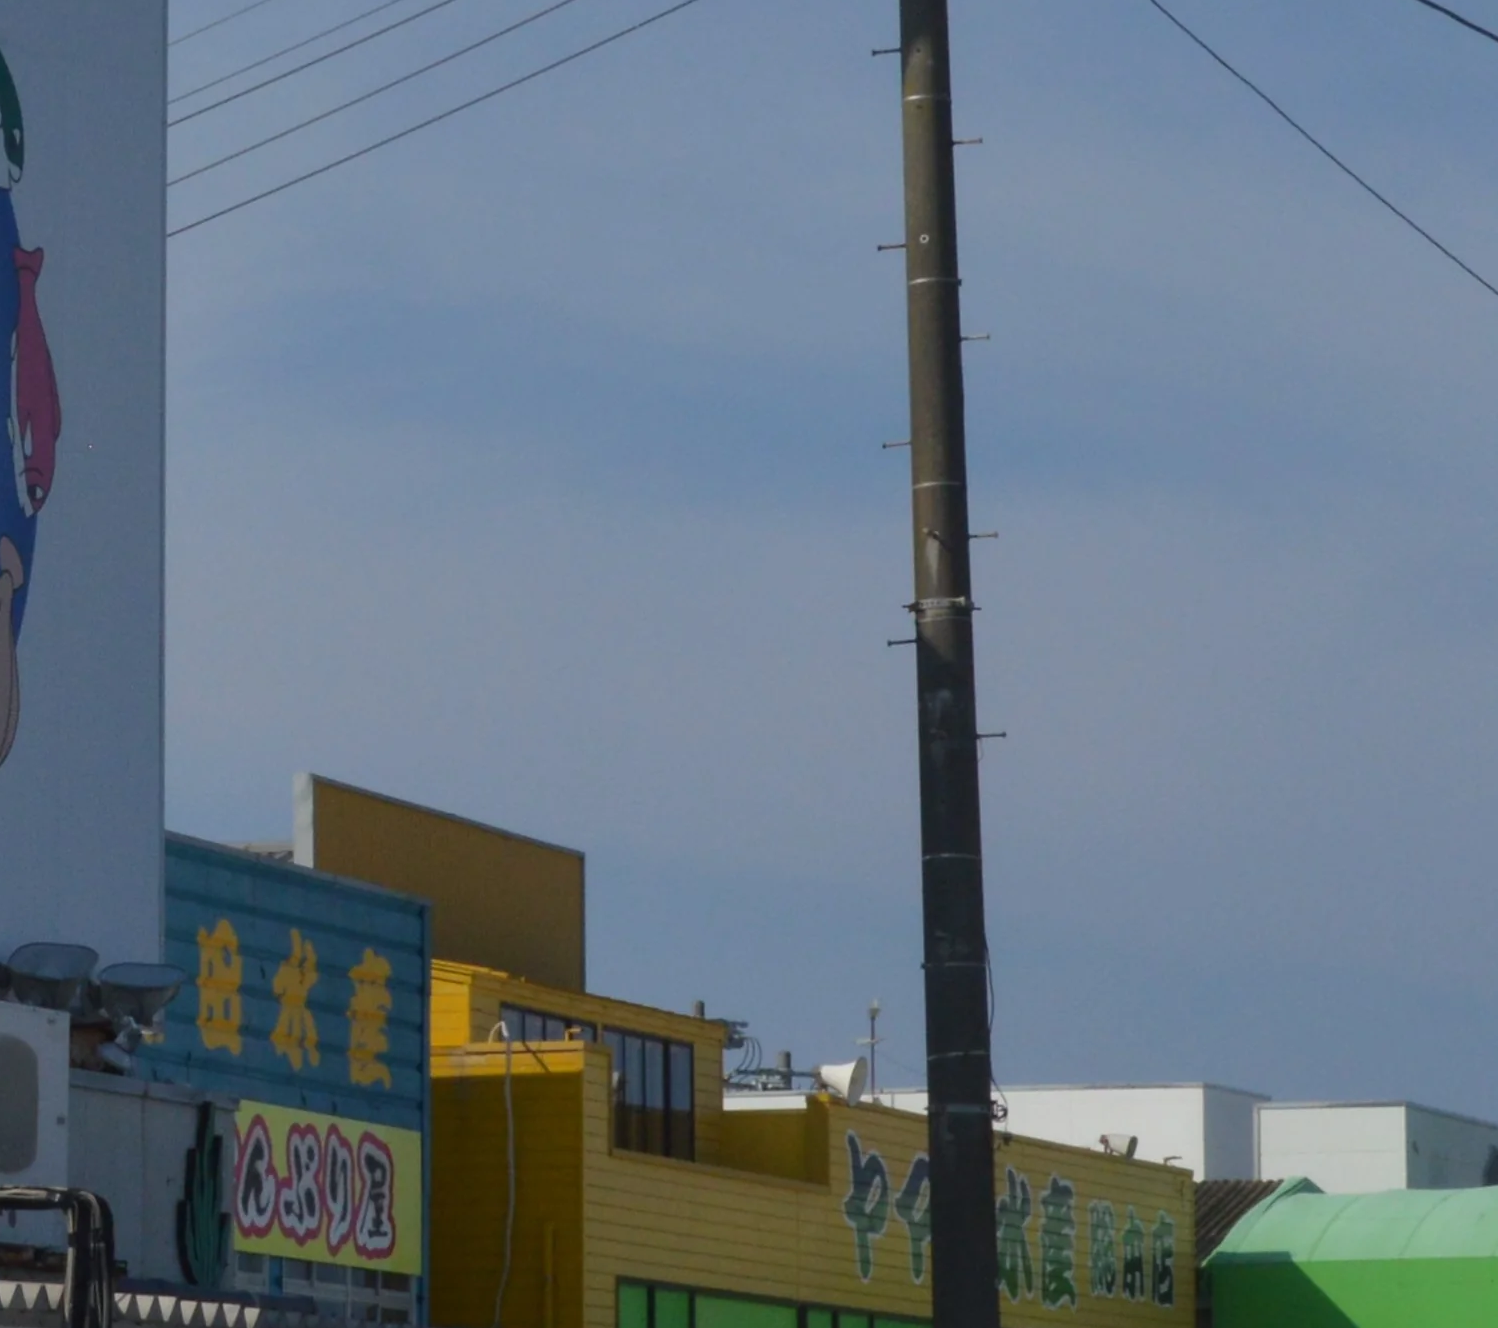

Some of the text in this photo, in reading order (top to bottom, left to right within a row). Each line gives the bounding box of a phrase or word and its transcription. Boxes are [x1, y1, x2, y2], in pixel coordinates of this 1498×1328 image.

[194, 917, 395, 1091] 田水産
[236, 1114, 398, 1261] んぶり屋
